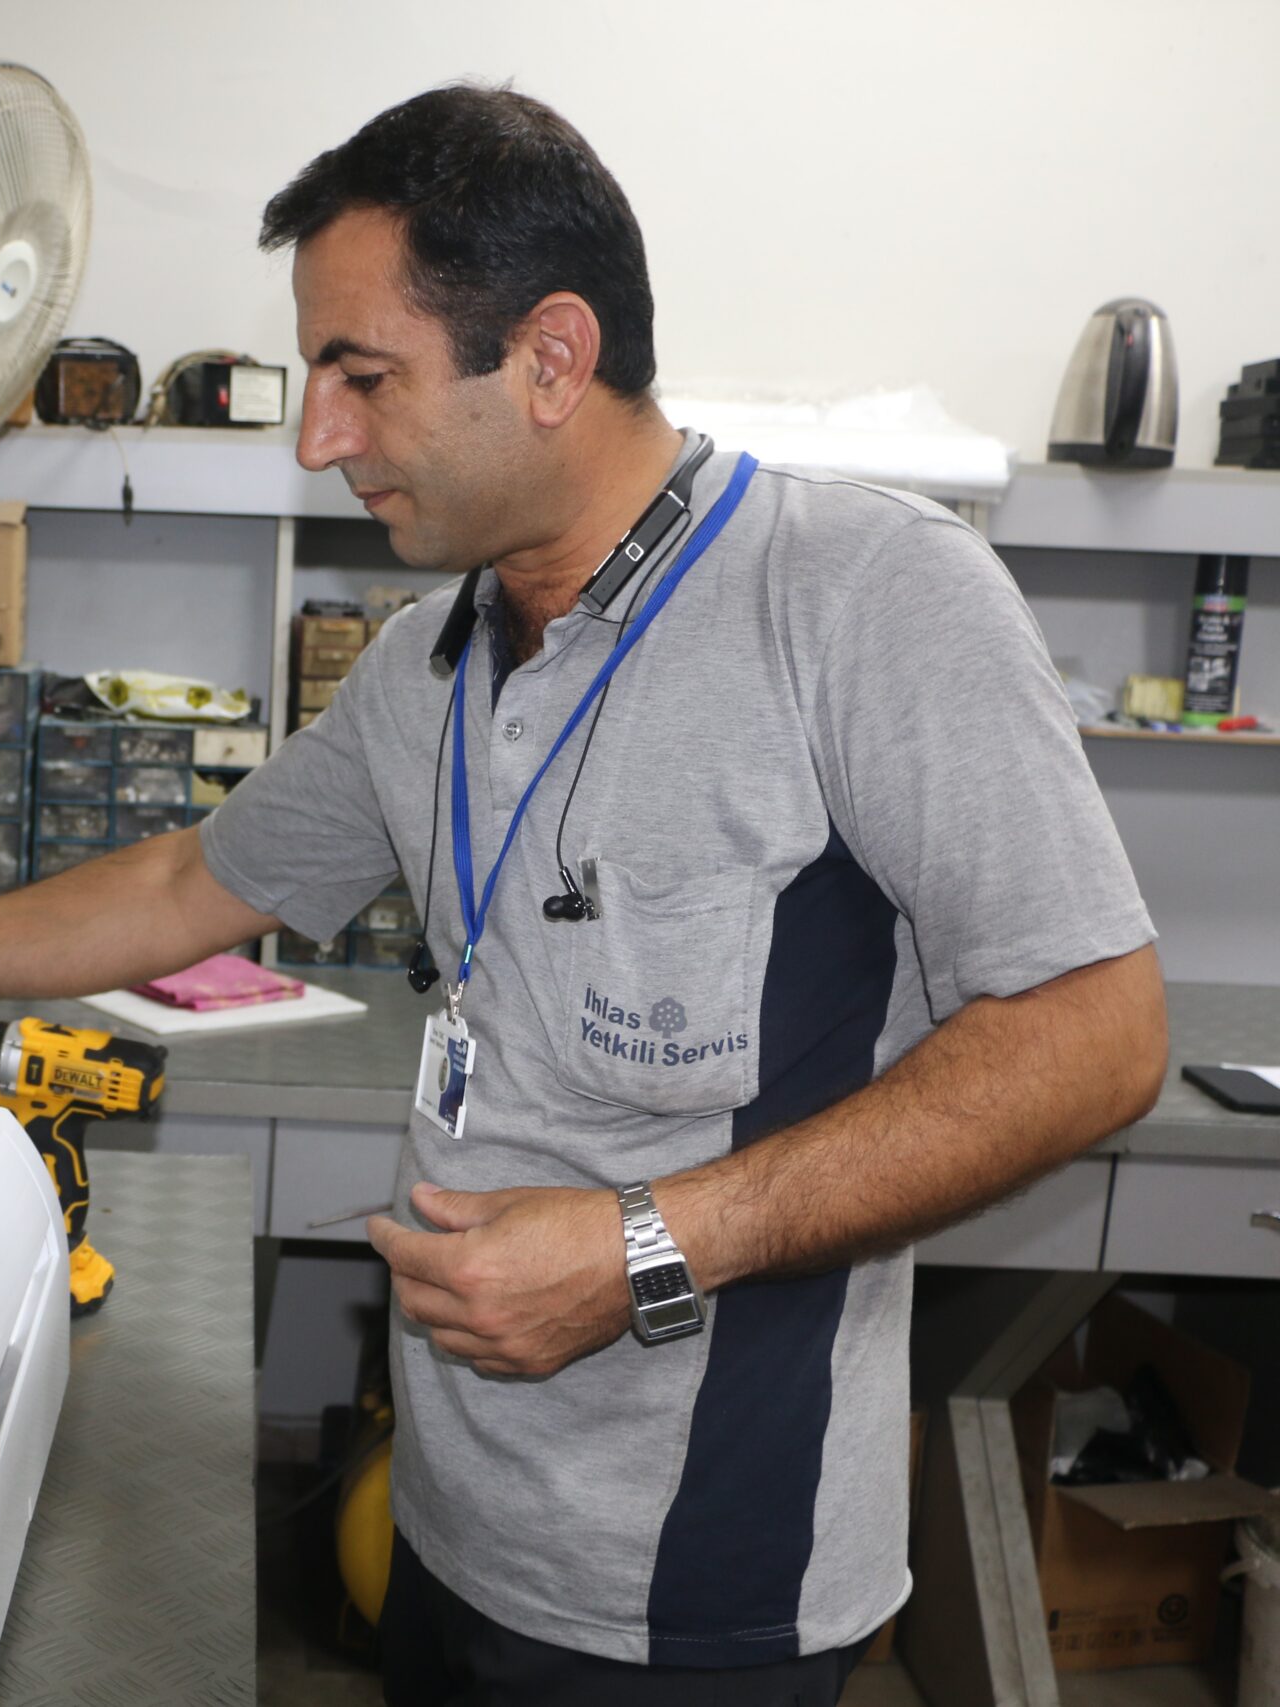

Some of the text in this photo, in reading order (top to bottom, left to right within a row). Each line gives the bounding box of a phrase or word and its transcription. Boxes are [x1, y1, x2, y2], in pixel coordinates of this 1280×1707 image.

[584, 983, 641, 1029] İhlas
[581, 1016, 748, 1066] Yetkili Servis
